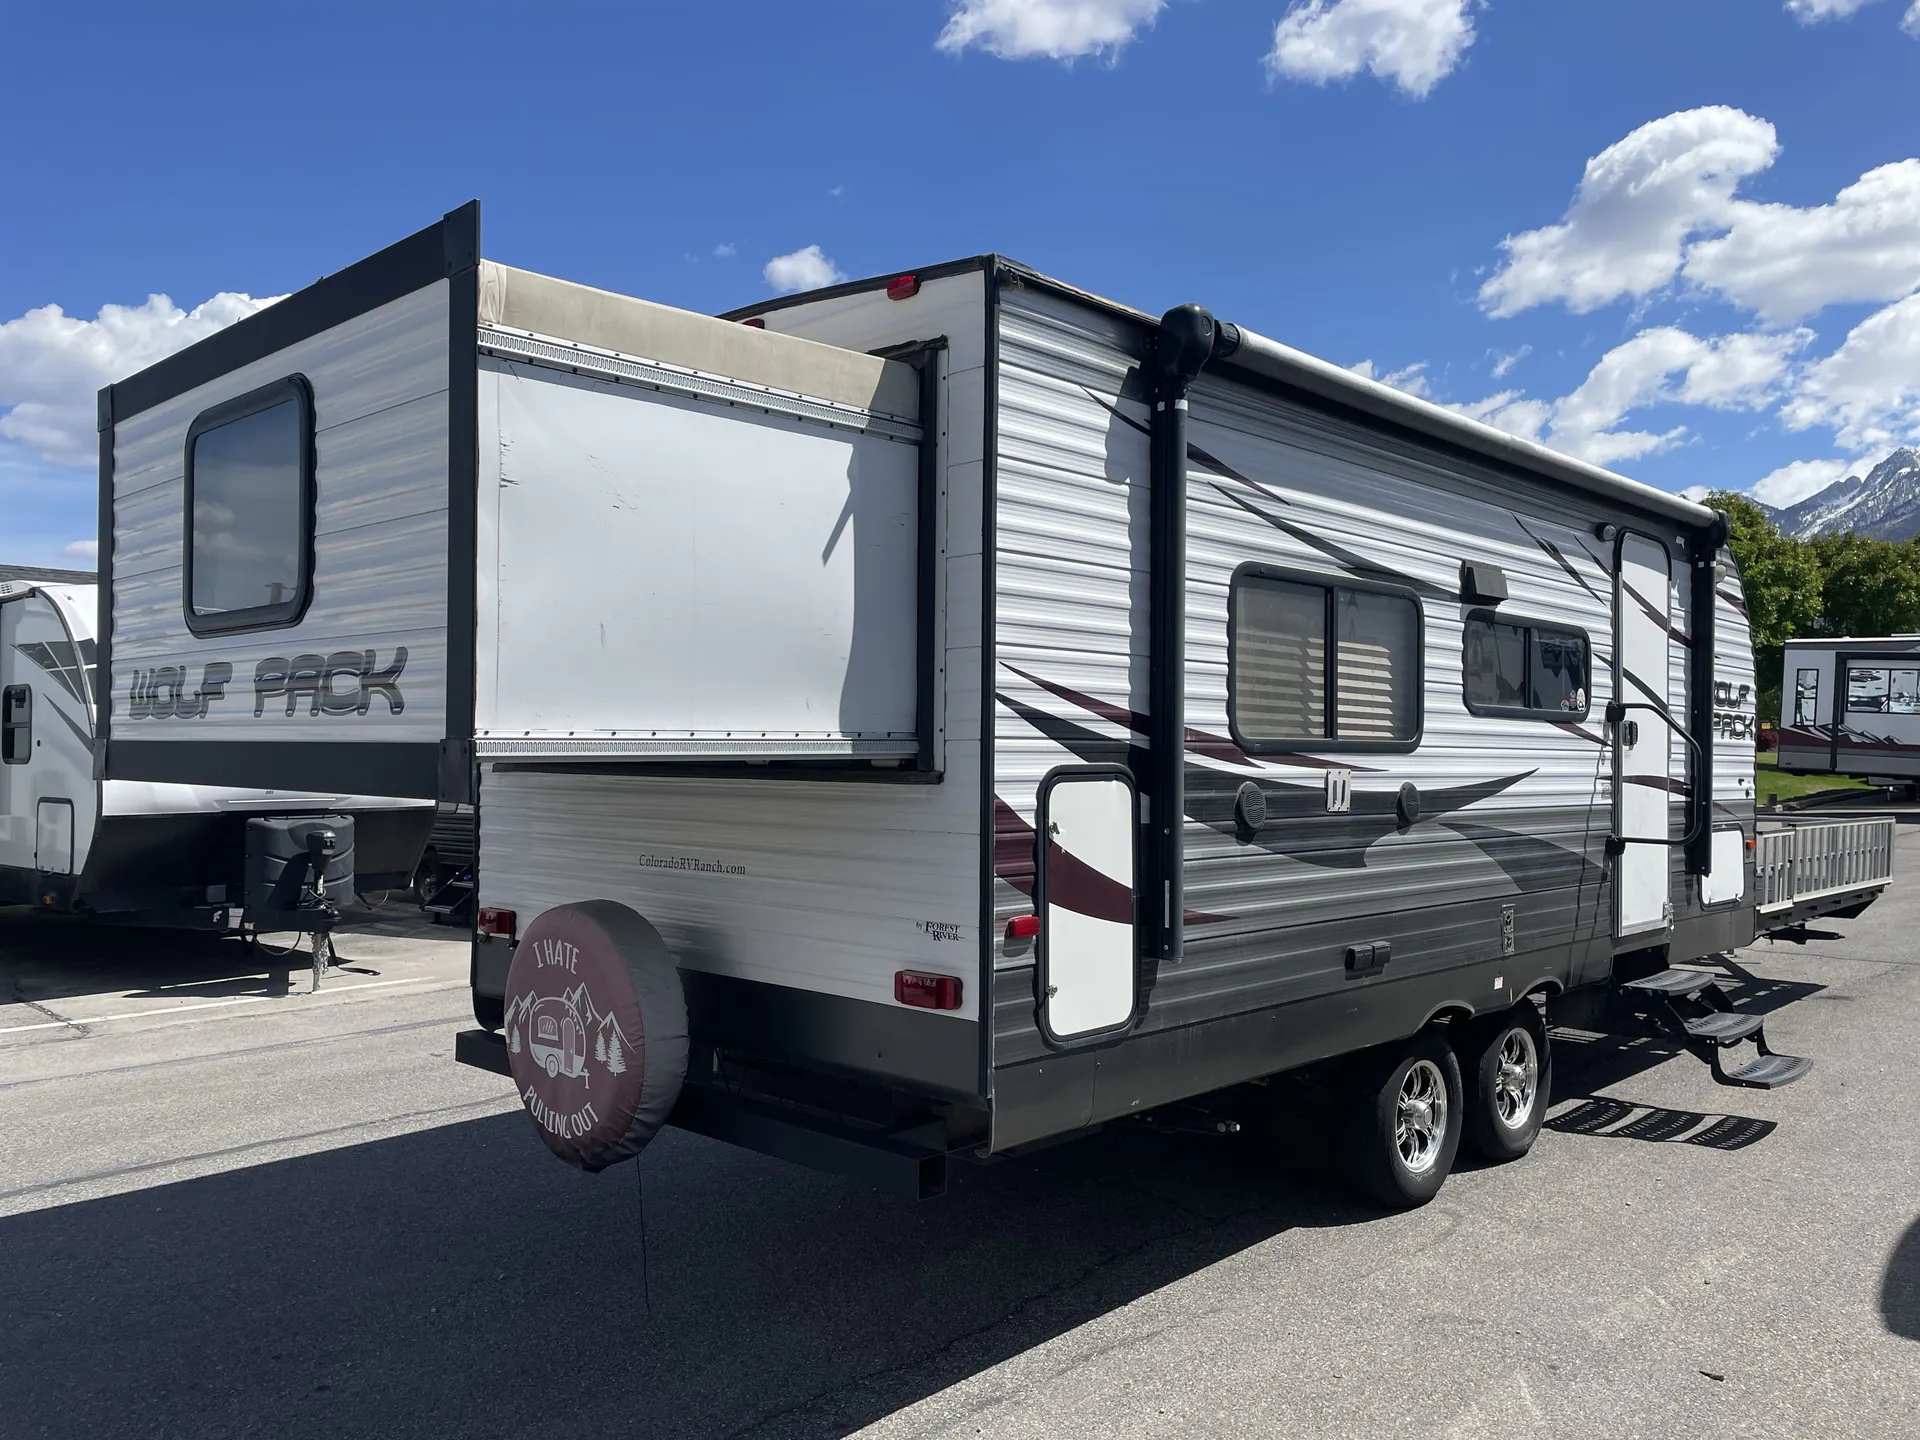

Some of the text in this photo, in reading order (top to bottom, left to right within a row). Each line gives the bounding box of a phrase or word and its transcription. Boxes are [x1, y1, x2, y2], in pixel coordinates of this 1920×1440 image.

[129, 646, 409, 720] WOLF PACK
[1713, 681, 1750, 709] OLF
[639, 854, 746, 875] ColoradoRVRanch.com
[532, 938, 580, 975] I HATE
[523, 1084, 599, 1140] PULLING OUT
